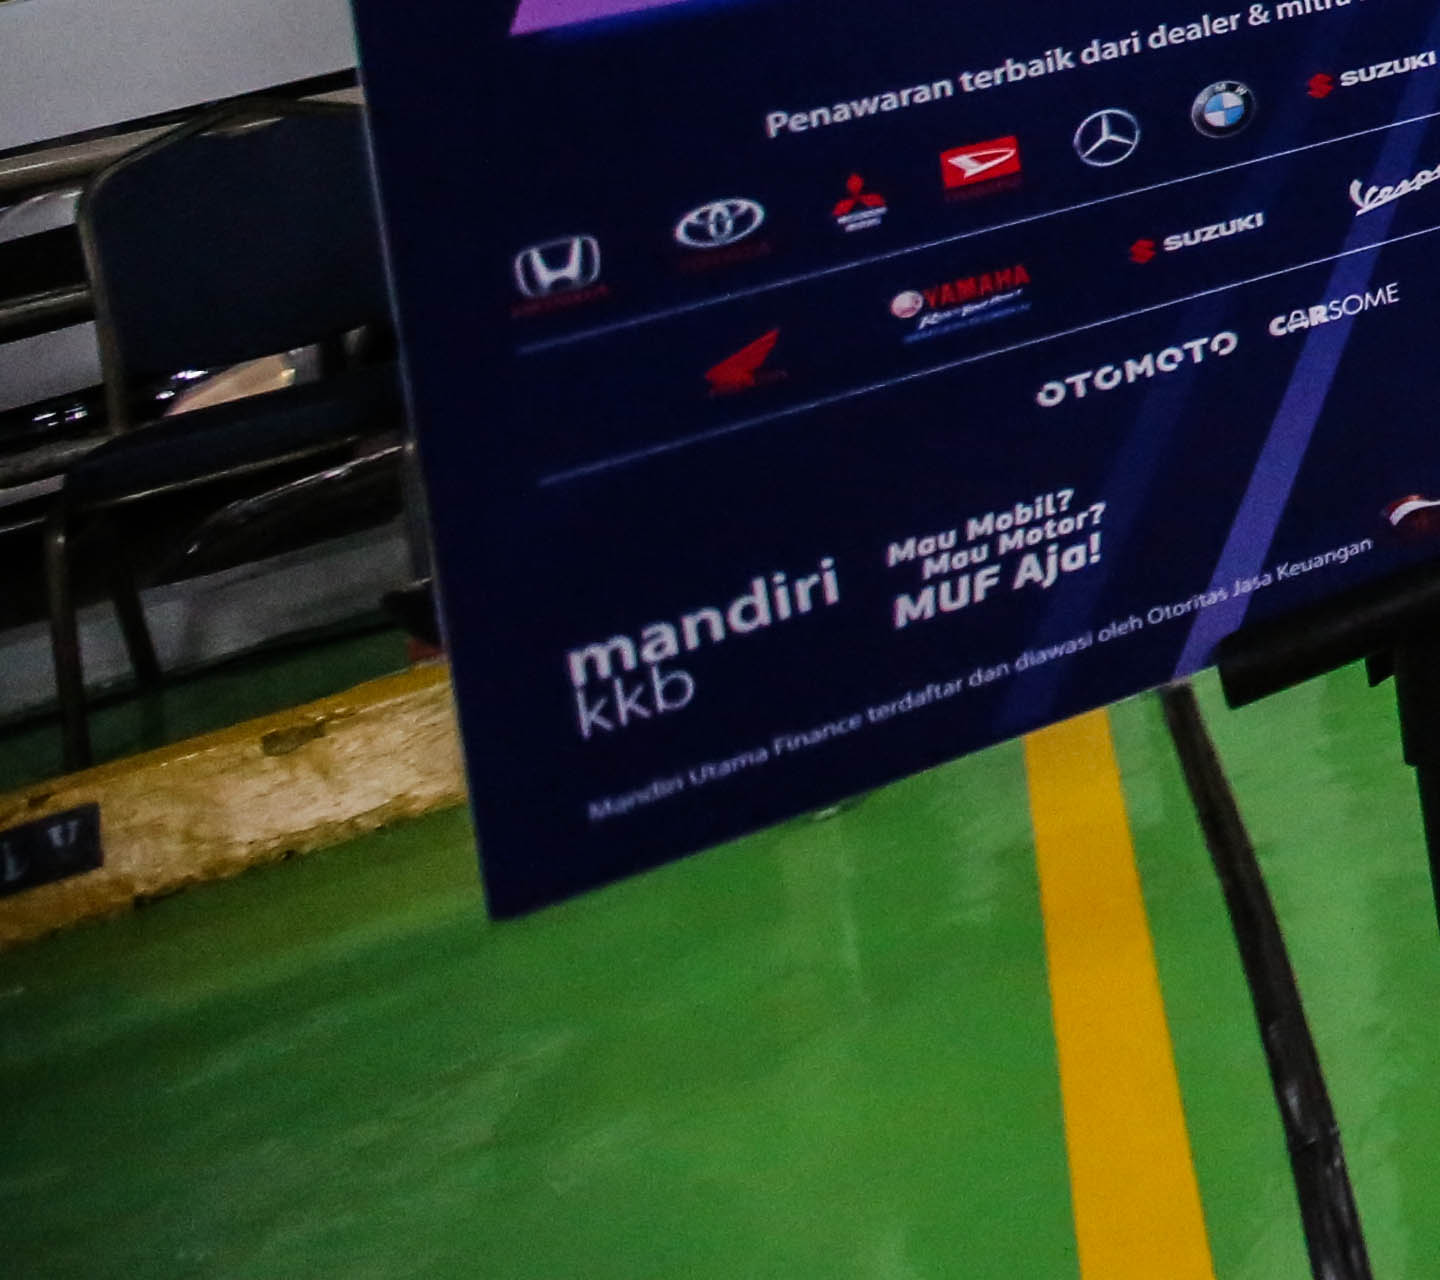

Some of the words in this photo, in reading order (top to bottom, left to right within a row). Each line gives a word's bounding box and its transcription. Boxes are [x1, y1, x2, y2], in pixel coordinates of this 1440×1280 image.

[765, 78, 954, 138] Penawaran
[958, 46, 1076, 92] terbaik
[1079, 29, 1142, 65] dari
[1146, 12, 1241, 49] dealer
[1247, 2, 1271, 26] &
[1340, 51, 1437, 87] SUZUKI
[1163, 212, 1265, 253] SUZUKI
[922, 264, 1031, 308] YAMAHA
[1268, 282, 1401, 337] CARSOME
[1035, 331, 1239, 407] OTOMOTO
[887, 528, 957, 567] Mau
[966, 488, 1074, 541] Mobil?
[922, 542, 989, 579] Mau
[997, 504, 1105, 555] Motor?
[894, 563, 1001, 628] MUF
[1012, 536, 1101, 590] Aja!
[566, 557, 841, 687] mandiri
[865, 677, 963, 723] terdaftar
[967, 662, 1010, 687] dan
[1013, 630, 1093, 672] diawasi
[1096, 614, 1144, 643] oleh
[1146, 585, 1230, 624] Otoritas
[1229, 571, 1272, 598] Jasa
[1275, 537, 1372, 581] Keuangan
[575, 662, 697, 740] kkb
